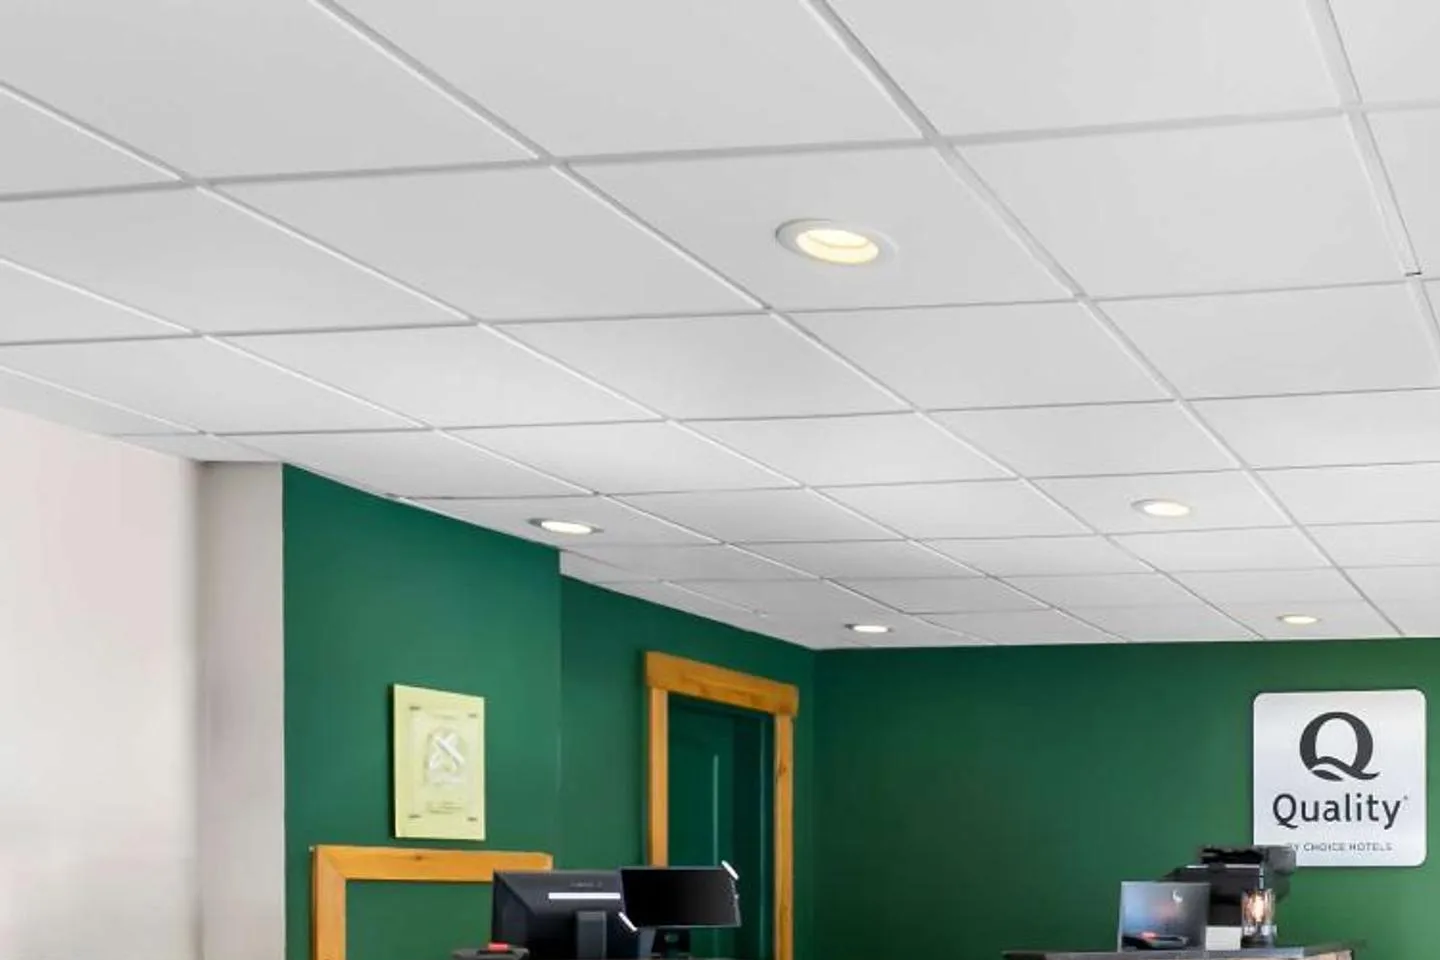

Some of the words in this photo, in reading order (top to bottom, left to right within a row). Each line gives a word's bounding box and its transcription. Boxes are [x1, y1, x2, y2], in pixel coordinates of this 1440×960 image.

[1300, 711, 1380, 782] Q
[1272, 793, 1402, 830] Quality
[1303, 842, 1344, 852] CHOICE
[1349, 842, 1393, 852] HOTELS
